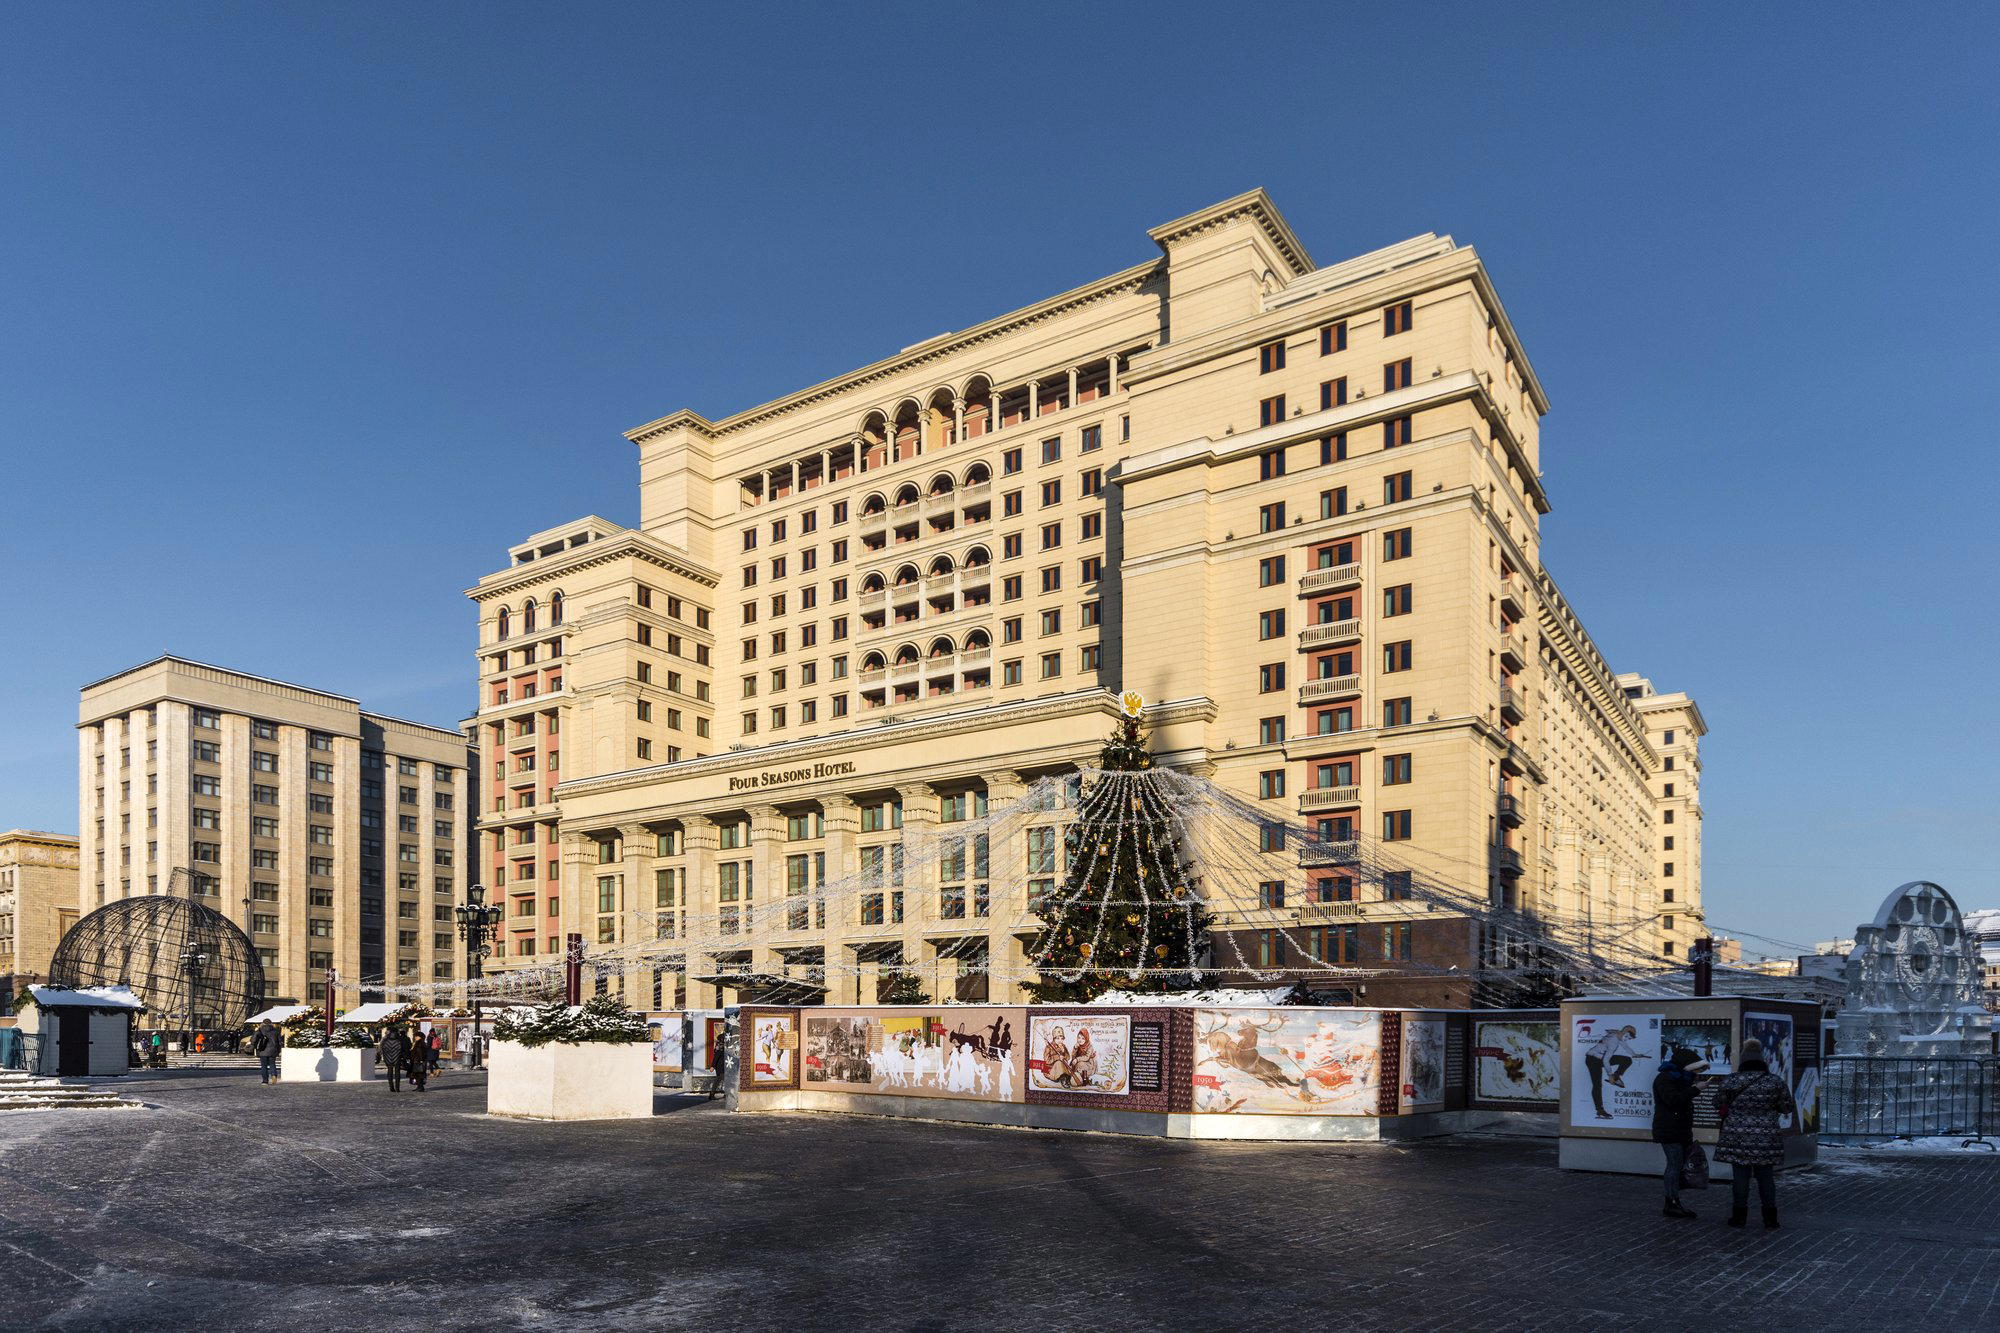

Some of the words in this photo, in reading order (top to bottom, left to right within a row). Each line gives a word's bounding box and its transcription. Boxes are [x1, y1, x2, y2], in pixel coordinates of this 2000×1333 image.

[729, 776, 759, 791] FOUR
[761, 768, 812, 787] SEASONS
[813, 761, 856, 779] HOTEL
[1197, 1076, 1213, 1085] 1950
